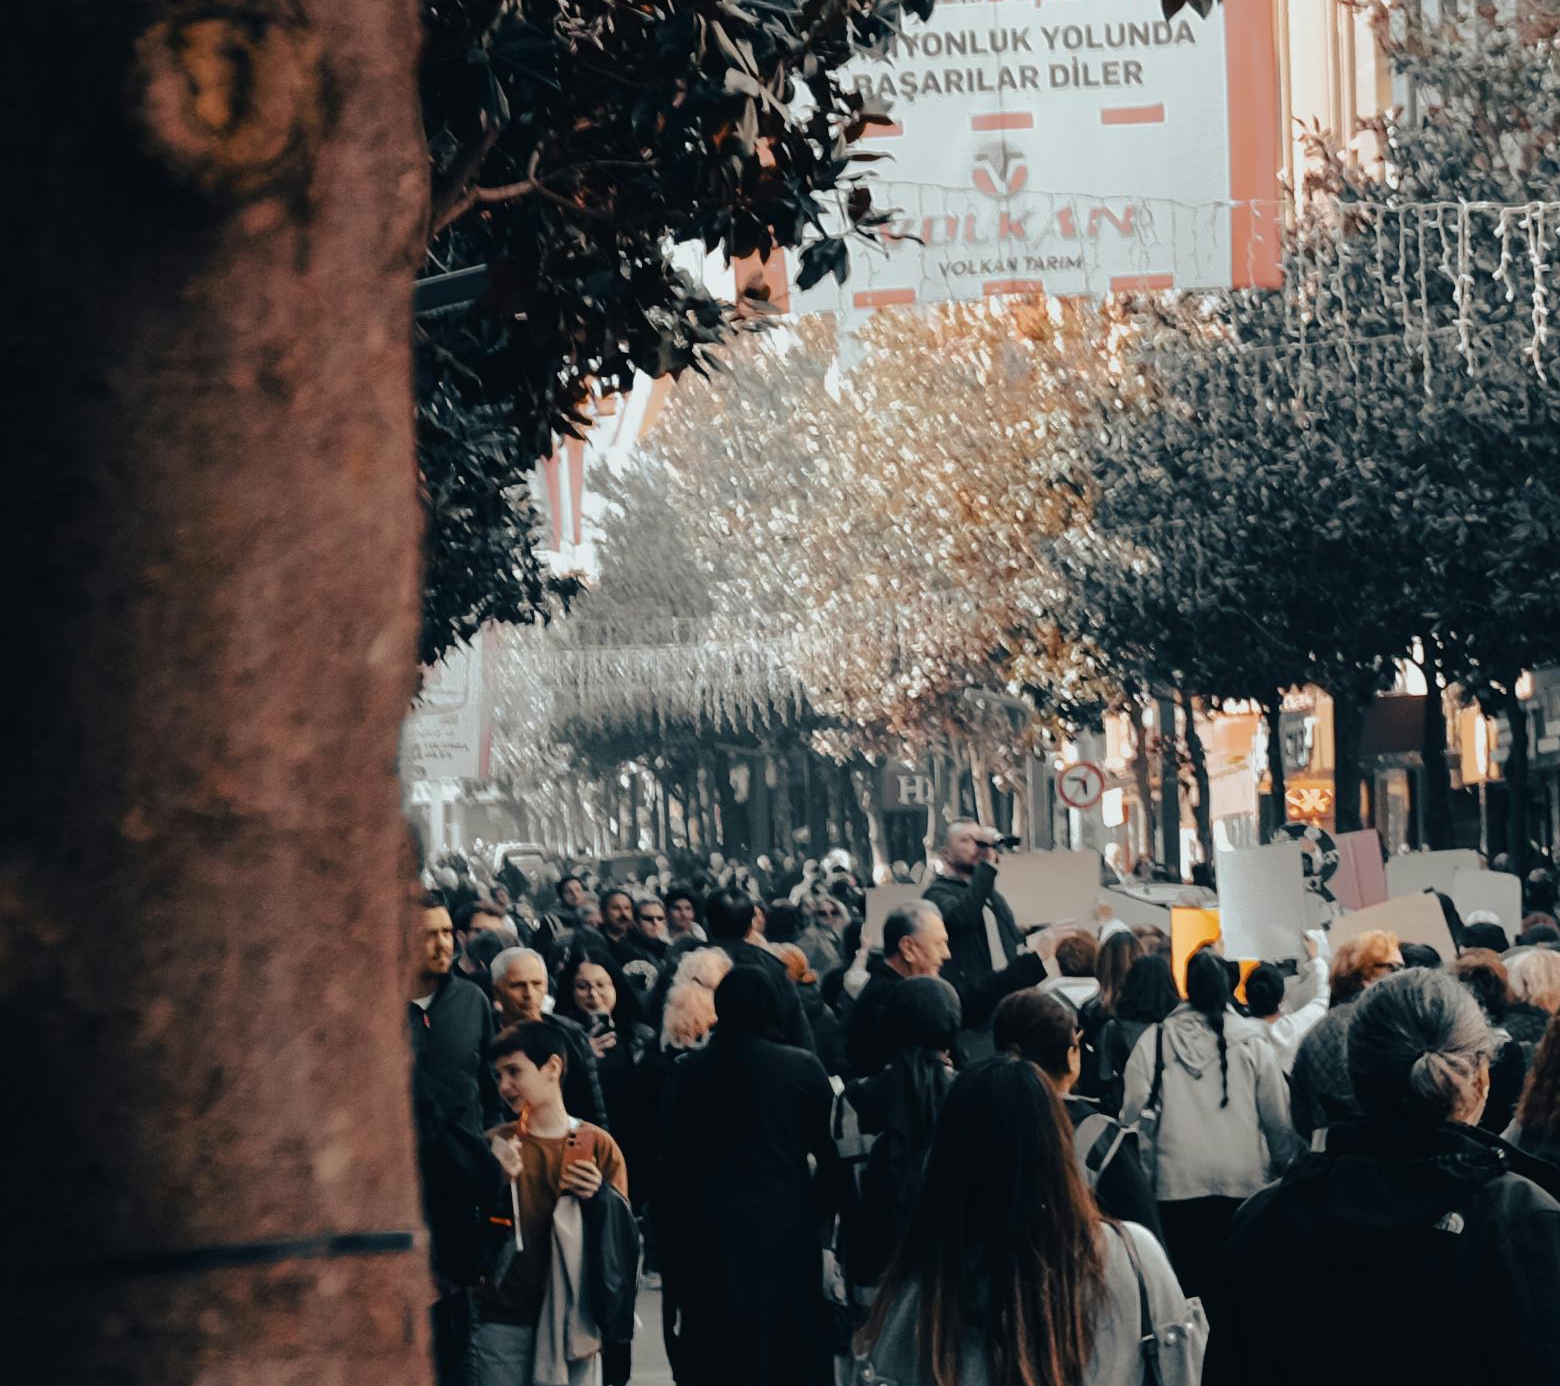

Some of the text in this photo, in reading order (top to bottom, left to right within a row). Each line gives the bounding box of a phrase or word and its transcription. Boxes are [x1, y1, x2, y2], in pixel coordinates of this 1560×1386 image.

[1041, 20, 1196, 50] YOLUNDA
[853, 56, 1144, 102] BAŞARILAR DİLER
[938, 255, 1018, 278] VOLKAN
